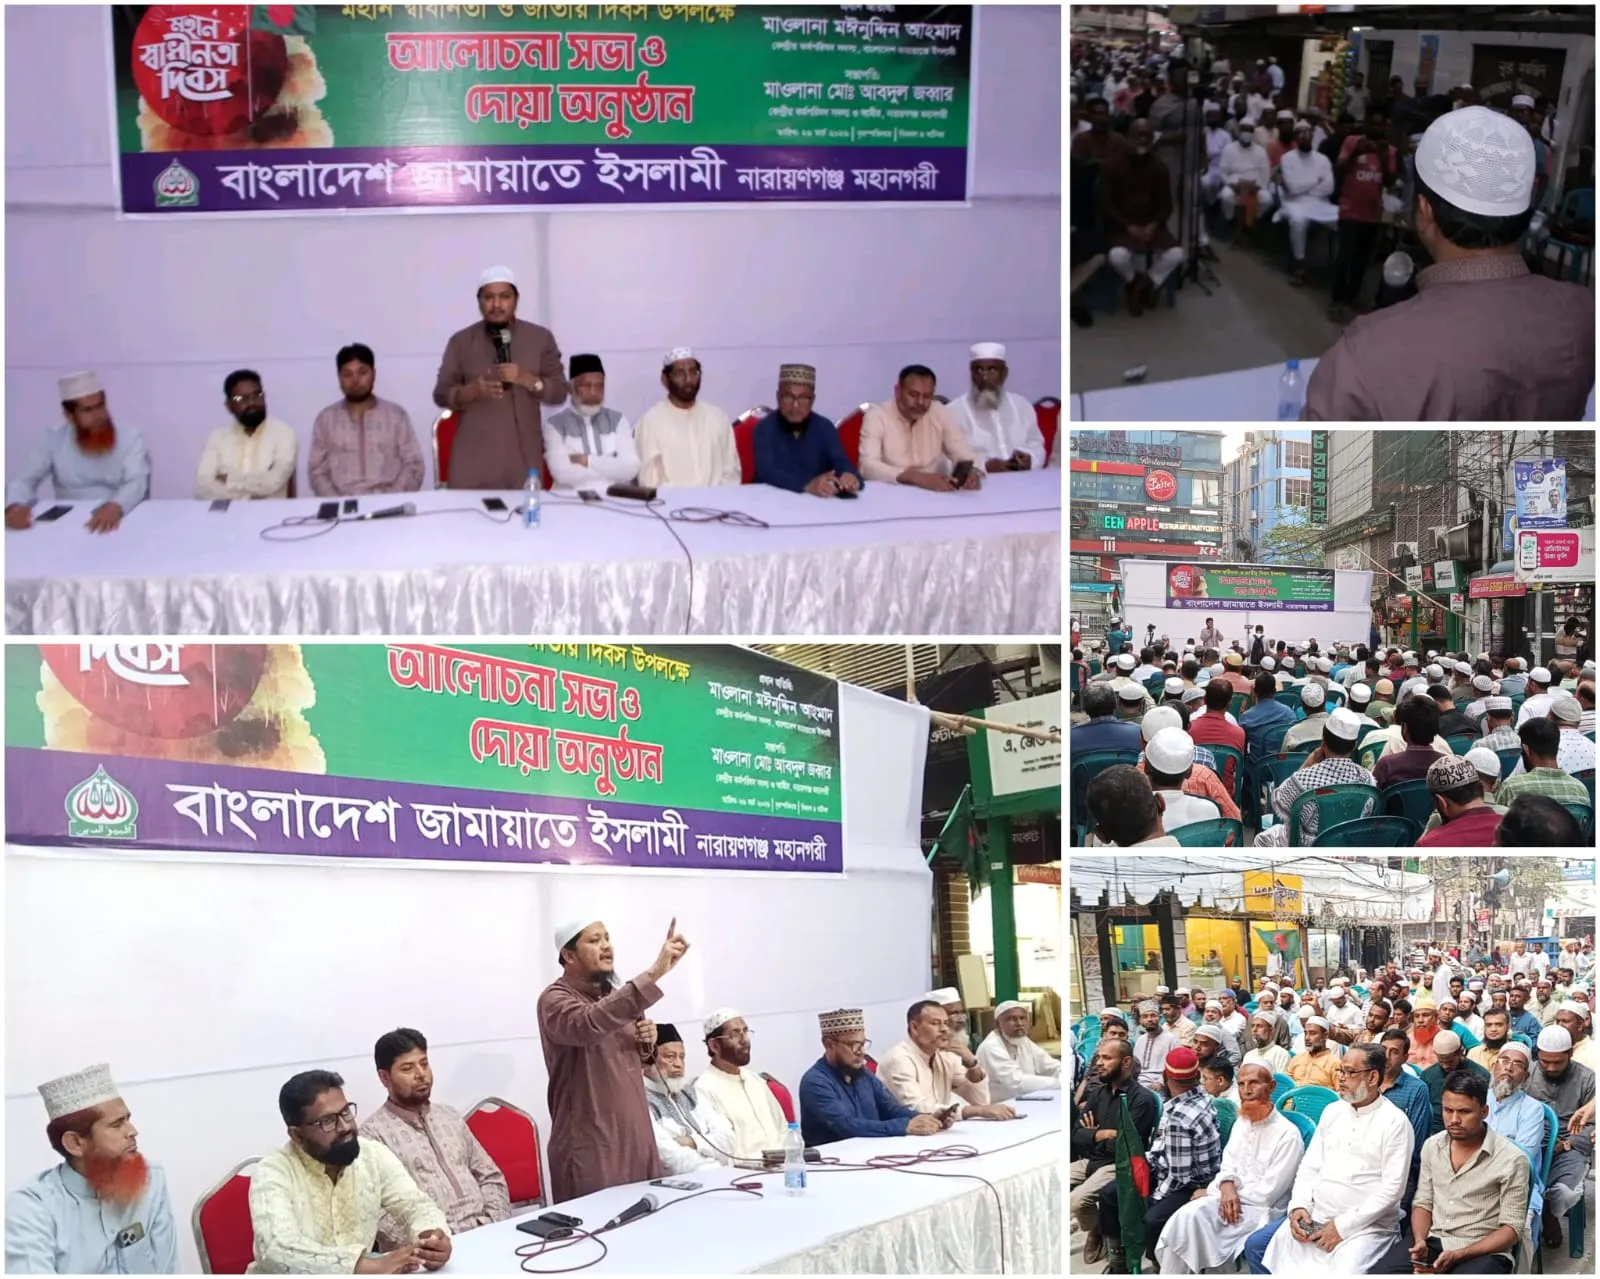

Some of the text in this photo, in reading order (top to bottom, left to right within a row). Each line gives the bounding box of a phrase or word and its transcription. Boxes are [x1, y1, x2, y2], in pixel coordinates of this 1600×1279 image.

[166, 14, 222, 40] মহান
[761, 15, 963, 41] মাওলানা মঈনুদ্দিন আহমাদ
[137, 32, 240, 70] স্বাধীনতা
[385, 32, 667, 71] আলোচনা সভা ও
[156, 60, 234, 101] দিবস
[763, 81, 824, 100] মাওলানা
[859, 84, 909, 105] আবদুল
[912, 85, 954, 102] জব্বার
[465, 70, 696, 138] দোয়া অনুষ্ঠান
[217, 145, 941, 201] বাংলাদেশ জামায়াতে ইসলামী নারায়ণগঞ্জ মহানগরী
[1127, 517, 1160, 532] APPLE
[385, 644, 642, 722] আলোচনা সভা ও
[632, 645, 691, 684] উপলক্ষে
[708, 681, 834, 724] মাওলানা মঈনুদ্দিন আহমাদ
[470, 716, 664, 796] দোয়া অনুষ্ঠান
[711, 747, 752, 769] মাওলানা
[774, 757, 805, 779] আবদুল
[807, 762, 832, 780] জব্বার
[166, 781, 827, 862] বাংলাদেশ জামায়াতে ইসলামী নারায়ণগঞ্জ মহানগরী
